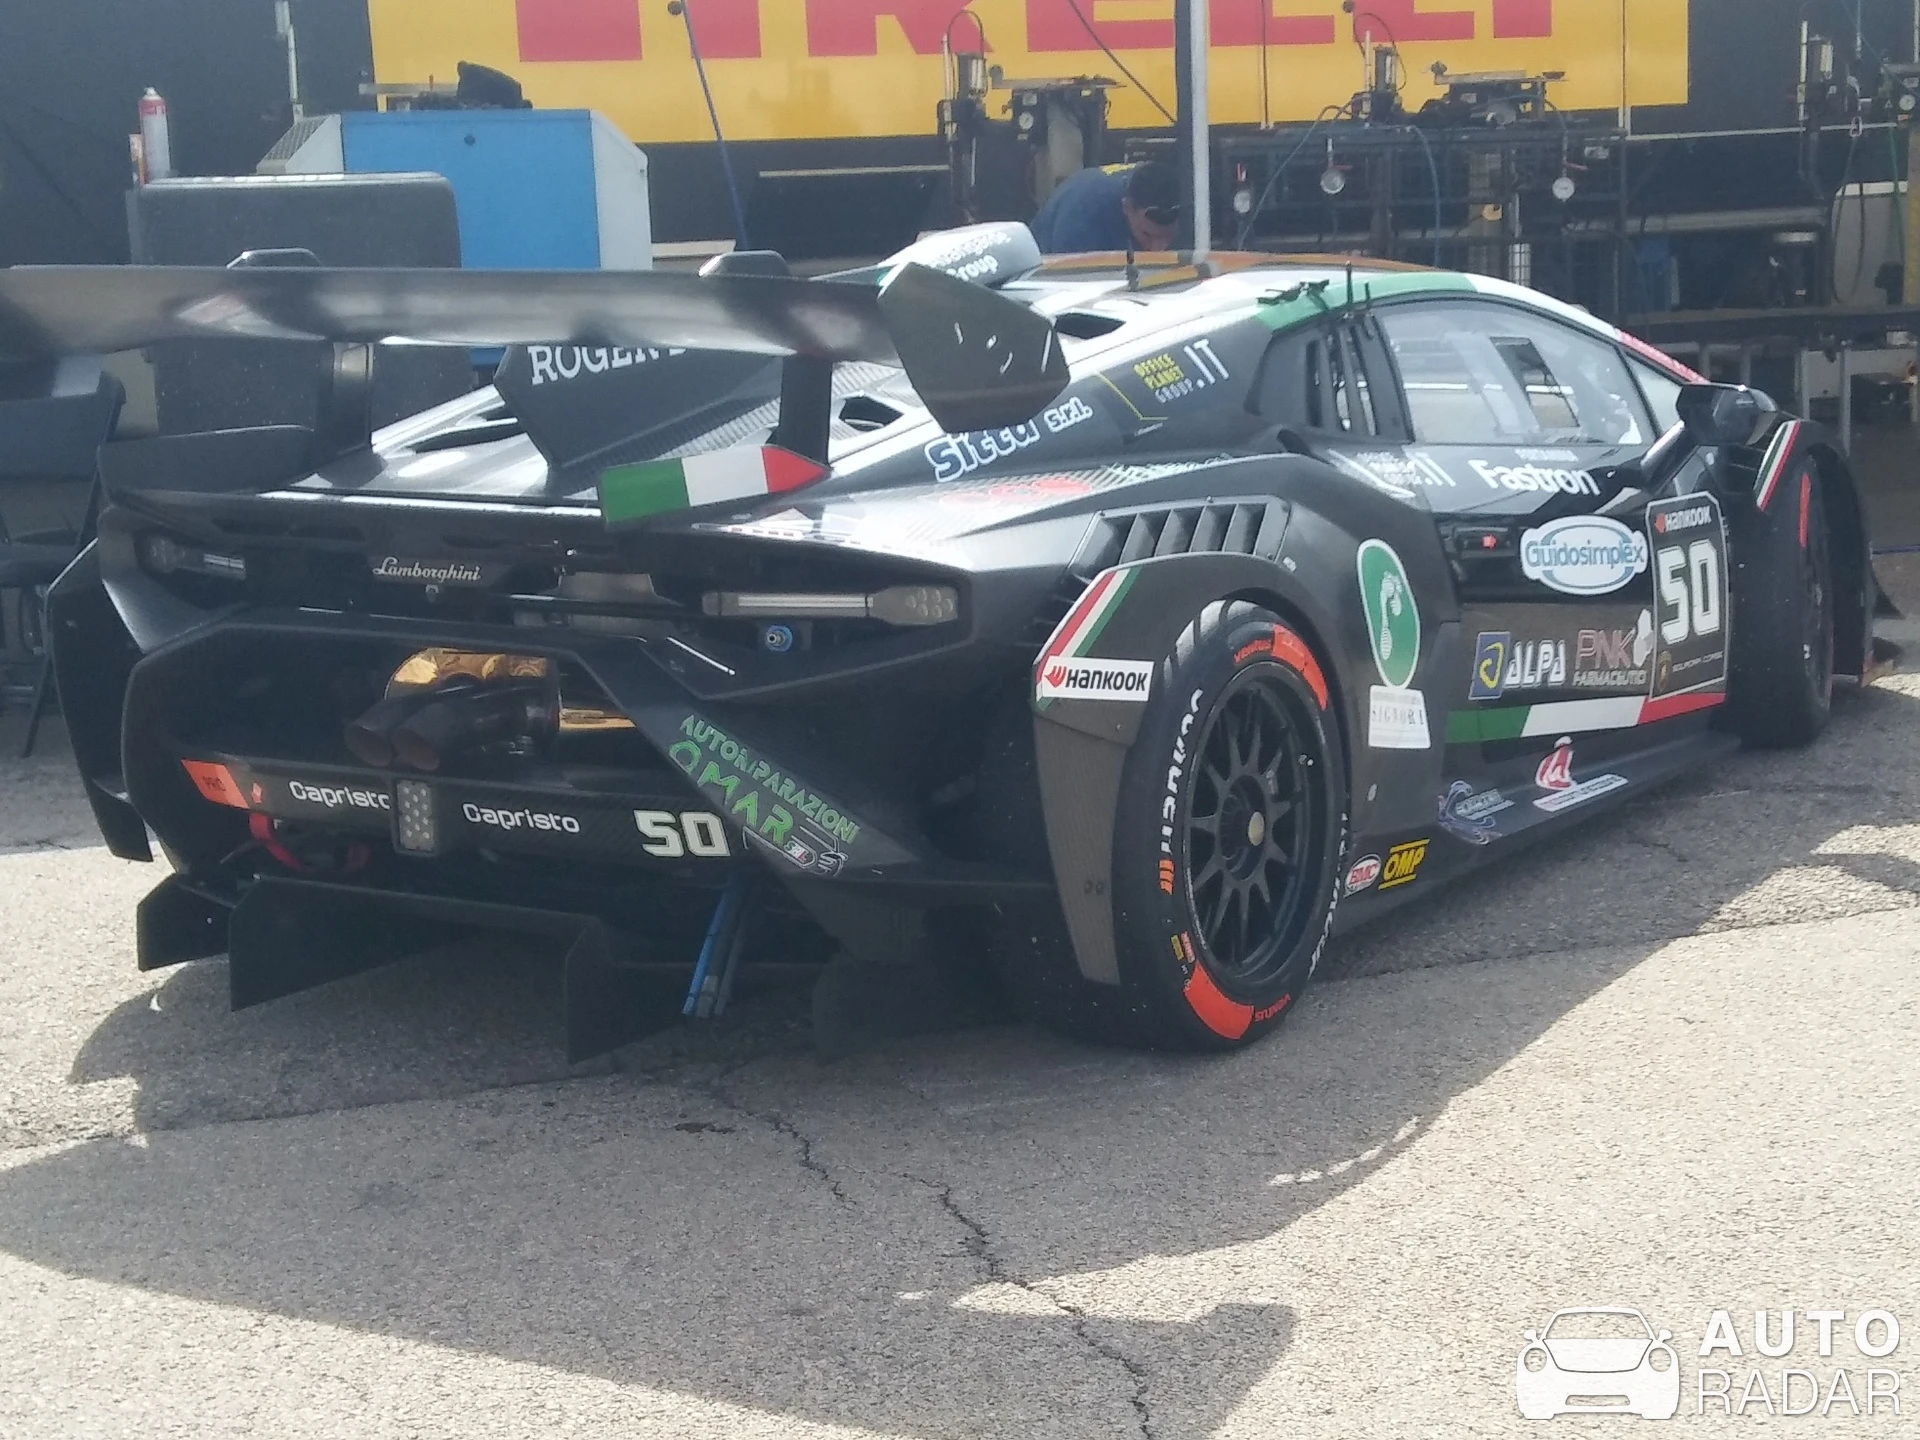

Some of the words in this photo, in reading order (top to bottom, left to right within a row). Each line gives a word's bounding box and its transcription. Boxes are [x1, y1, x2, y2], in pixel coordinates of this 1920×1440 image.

[1468, 457, 1600, 495] Fastron
[372, 556, 481, 583] Lamborghini
[1525, 540, 1645, 569] Guidosimplex
[1657, 539, 1720, 645] 50
[1504, 640, 1567, 688] ALPA
[1574, 629, 1636, 669] PNK
[669, 740, 795, 846] OMAR
[462, 803, 580, 834] Capristo
[633, 810, 731, 857] 50
[1383, 846, 1425, 881] OMP
